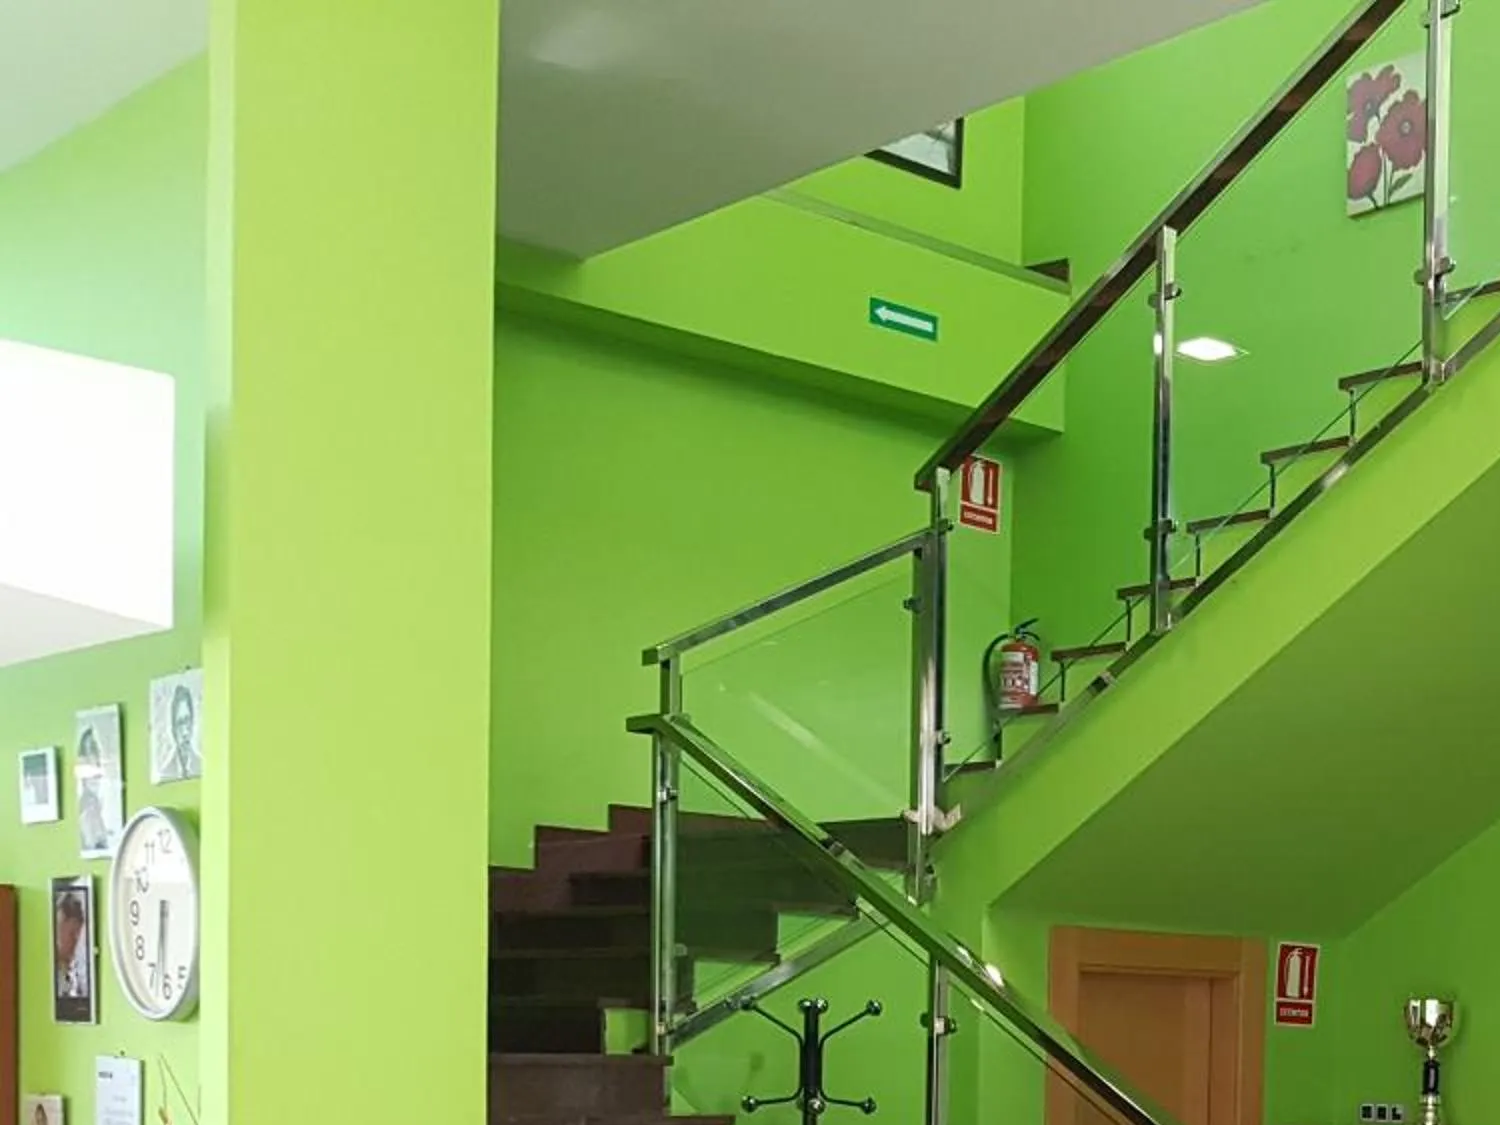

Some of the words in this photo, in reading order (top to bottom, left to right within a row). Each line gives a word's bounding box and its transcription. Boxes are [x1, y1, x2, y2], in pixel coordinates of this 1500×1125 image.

[129, 899, 140, 926] 9
[135, 935, 145, 961] 8
[147, 962, 157, 989] 7
[162, 972, 173, 1000] 6
